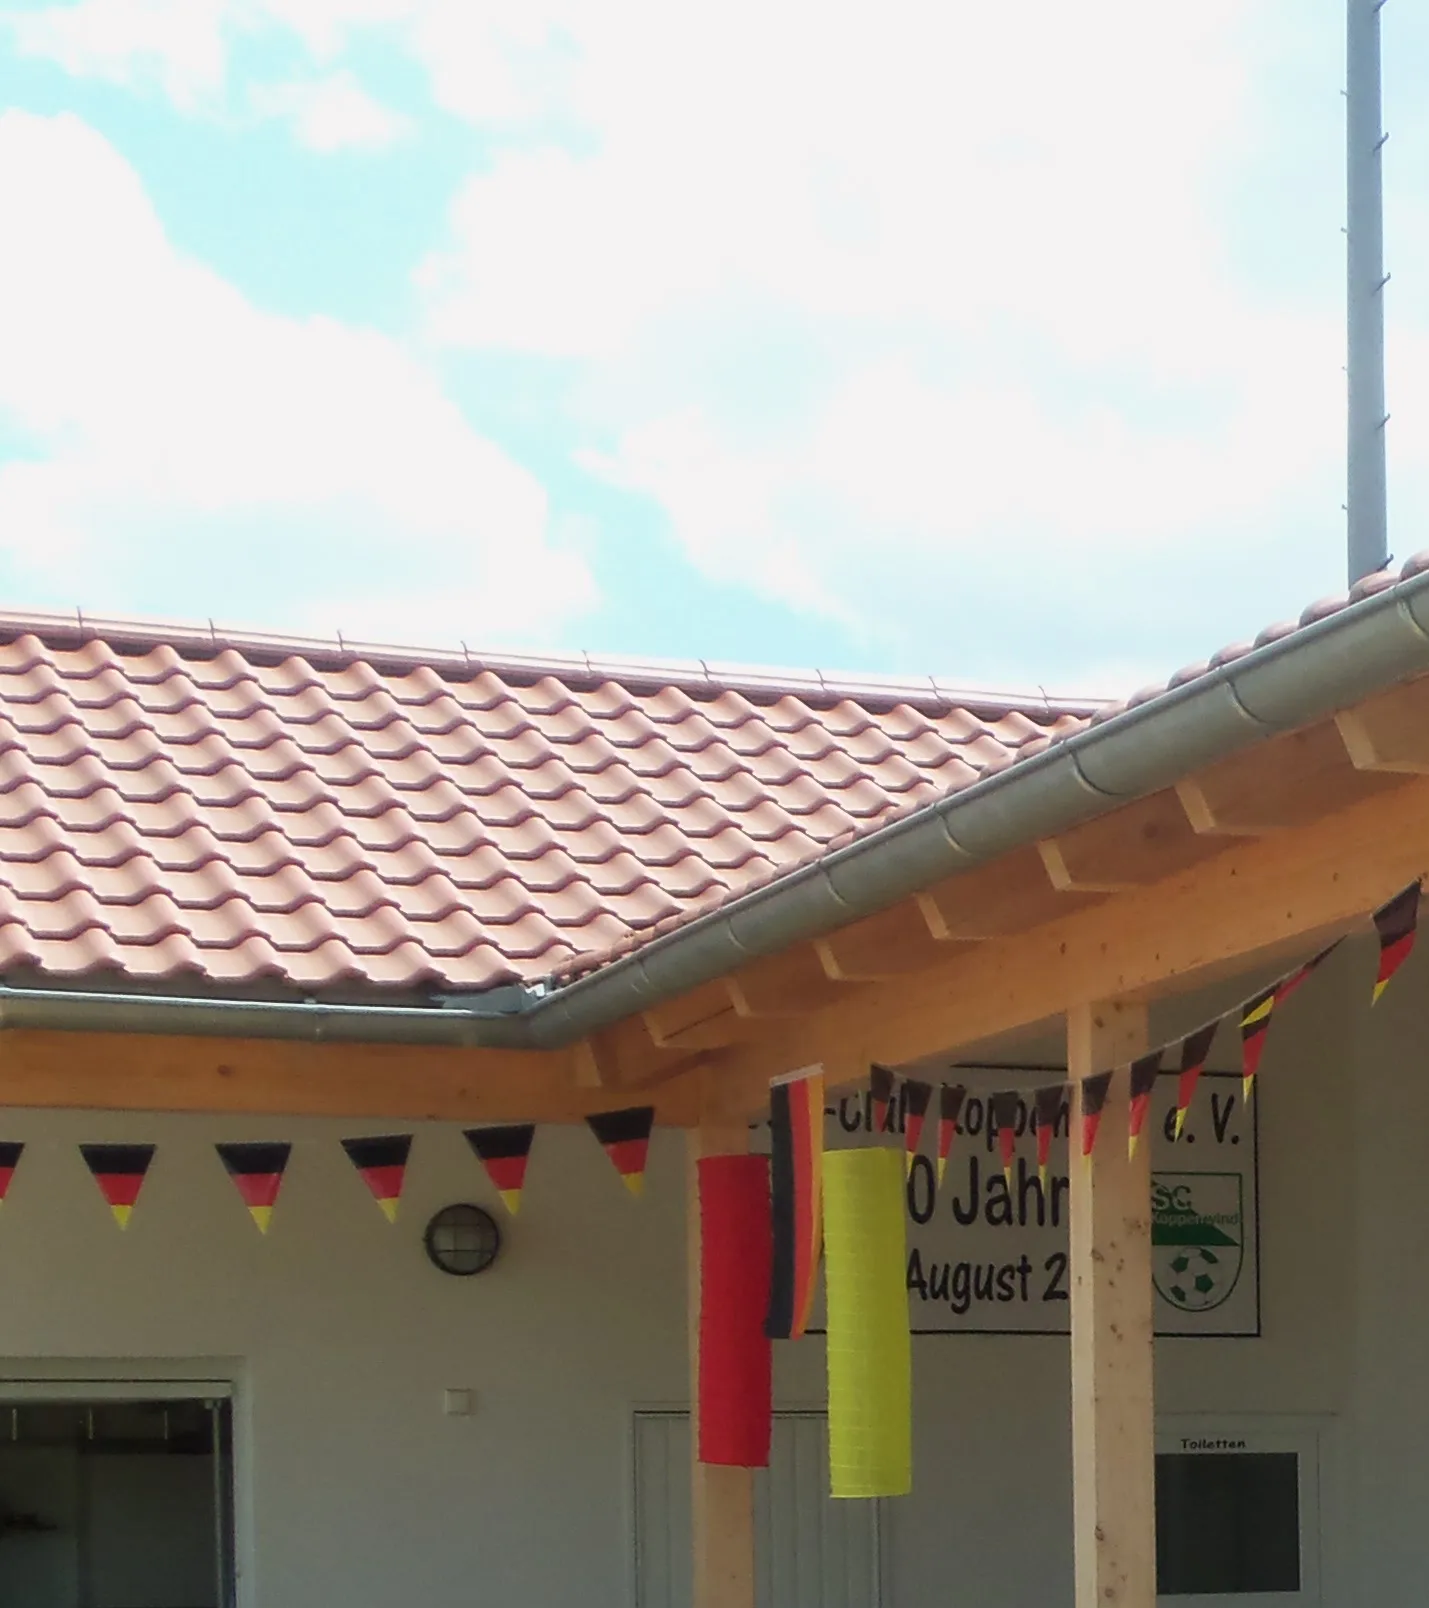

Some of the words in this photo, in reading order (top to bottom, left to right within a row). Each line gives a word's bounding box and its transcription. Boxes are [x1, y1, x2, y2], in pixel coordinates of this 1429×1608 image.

[1211, 1092, 1240, 1145] V.
[907, 1154, 935, 1225] 0
[953, 1155, 1069, 1228] Jahr
[906, 1248, 1032, 1314] August
[1180, 1438, 1247, 1450] Toiletten
